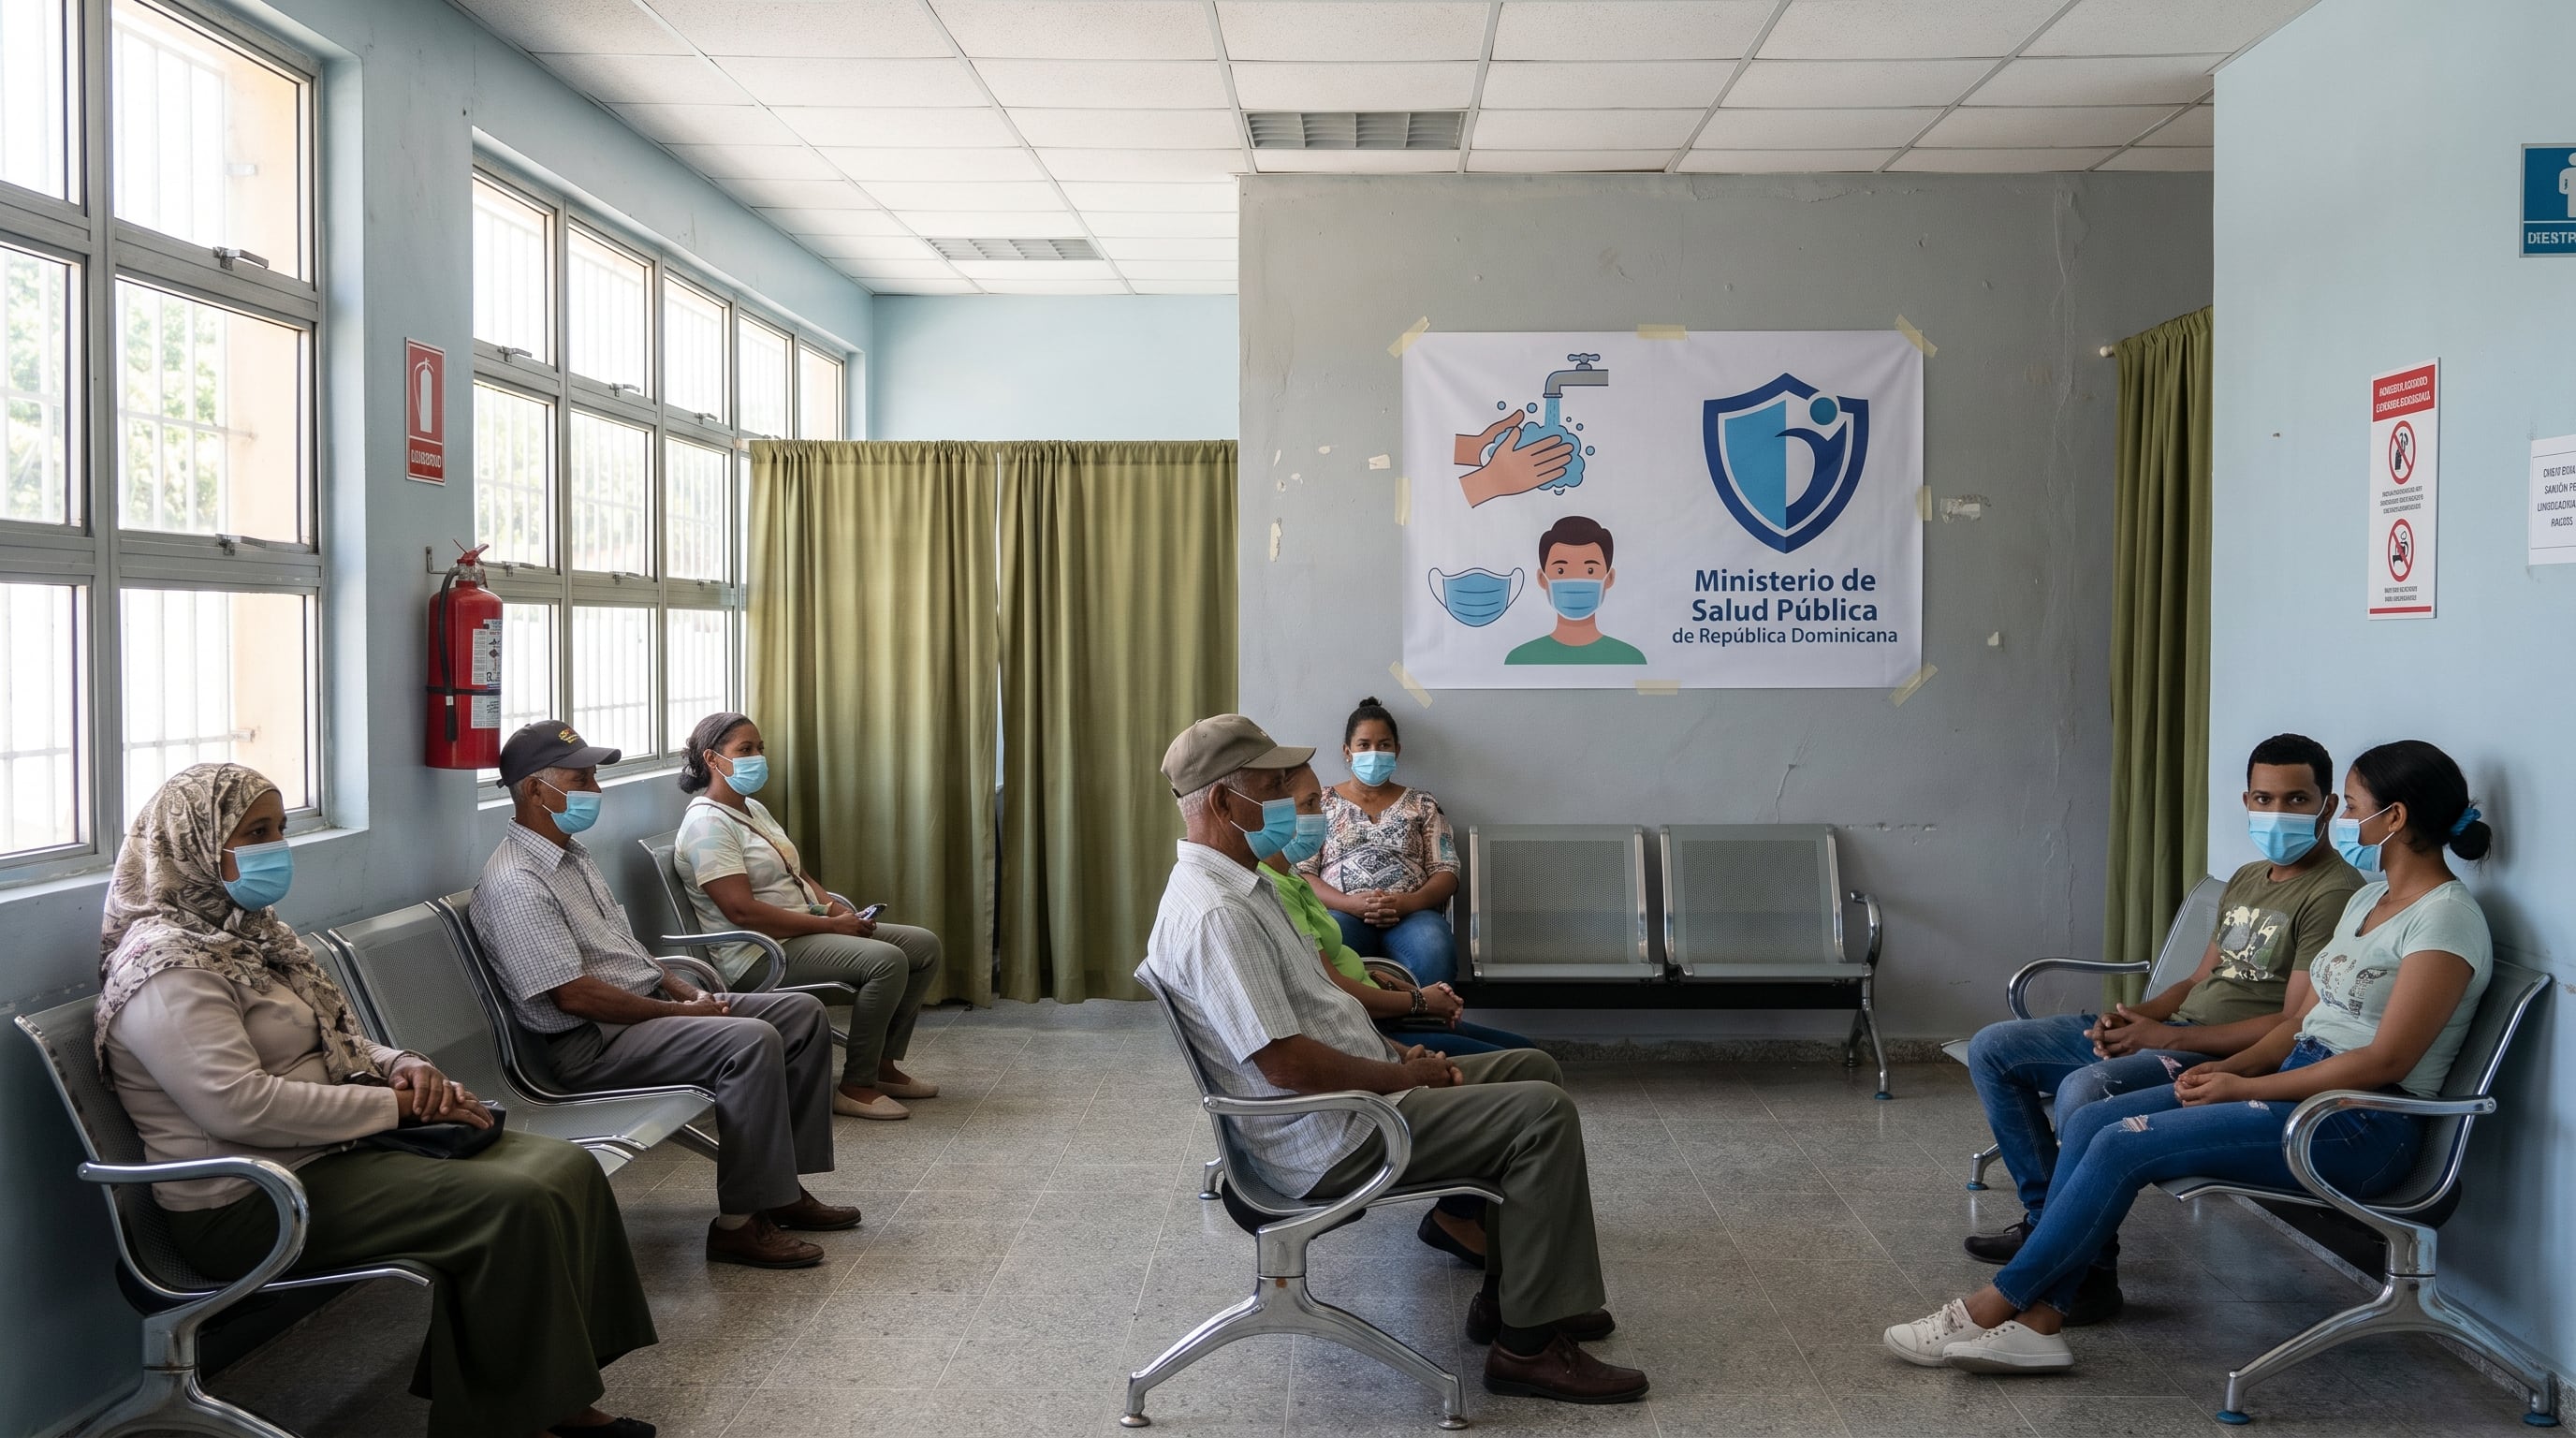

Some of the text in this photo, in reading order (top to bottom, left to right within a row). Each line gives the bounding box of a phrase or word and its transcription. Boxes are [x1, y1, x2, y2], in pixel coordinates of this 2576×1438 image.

[1694, 567, 1877, 592] Ministerio de
[1691, 597, 1878, 622] Salud Pública
[1672, 627, 1897, 647] de República Dominicana
